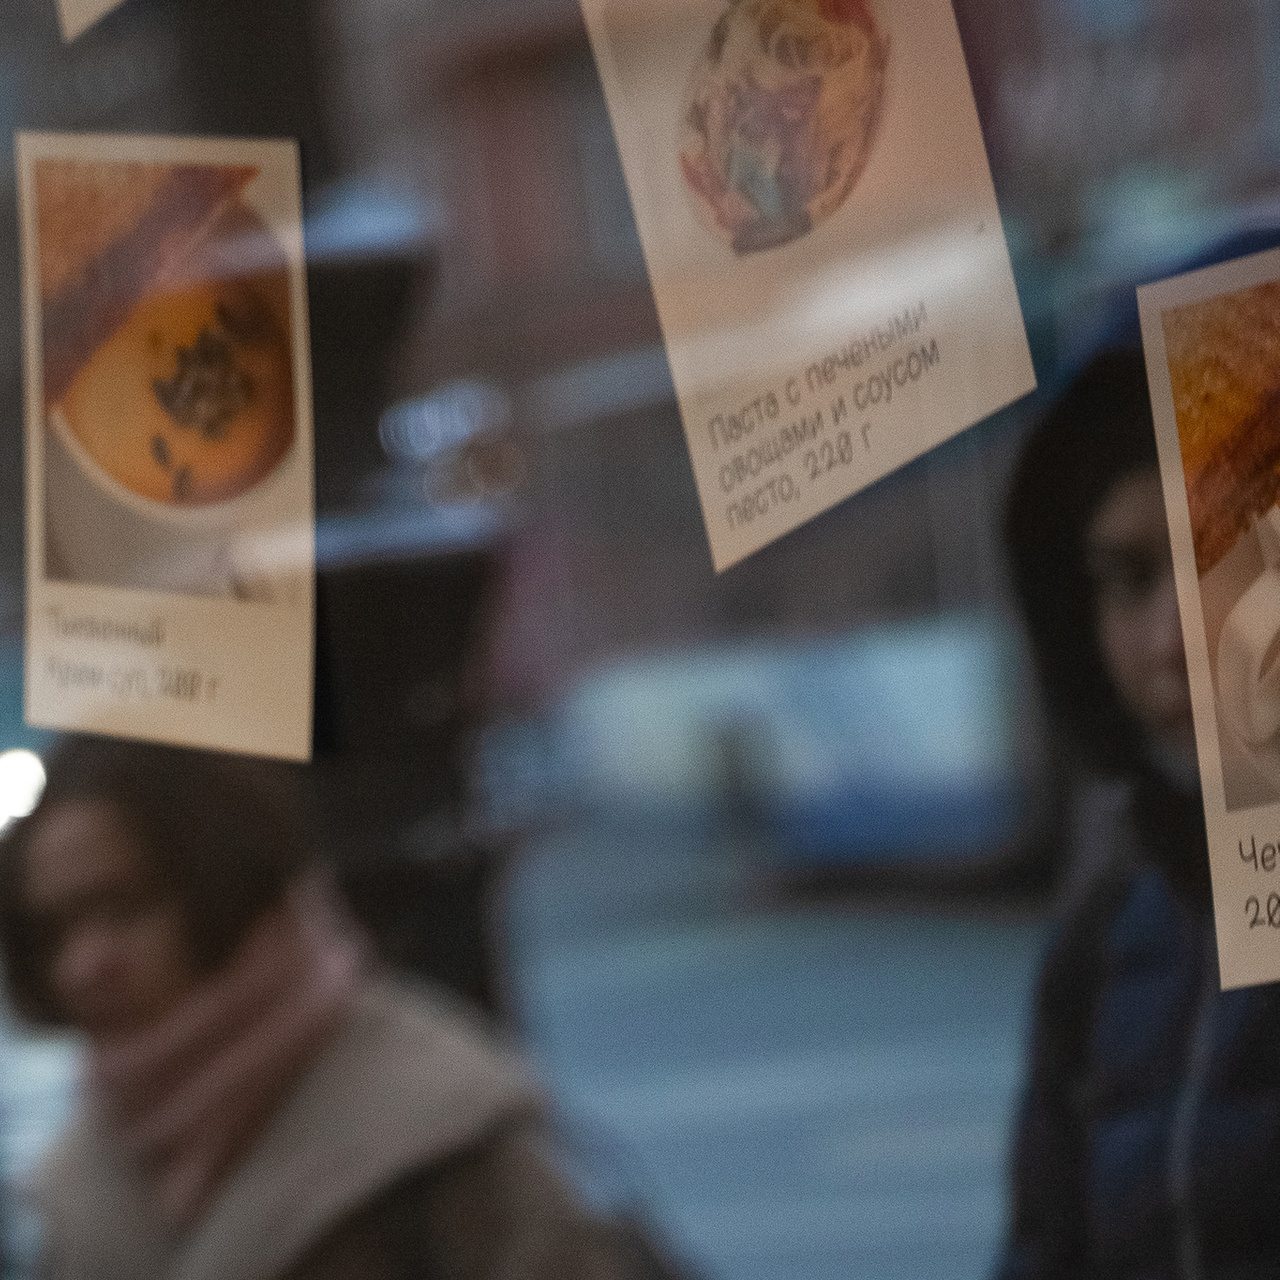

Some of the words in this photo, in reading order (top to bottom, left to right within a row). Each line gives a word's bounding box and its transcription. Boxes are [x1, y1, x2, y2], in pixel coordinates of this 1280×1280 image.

[707, 391, 780, 450] Паста
[784, 375, 802, 407] с
[804, 298, 928, 393] печеными
[718, 410, 825, 494] овощами
[829, 394, 848, 427] и
[852, 337, 941, 412] соусом
[724, 473, 803, 532] песто,
[802, 430, 854, 482] 220
[1238, 834, 1280, 873] Че
